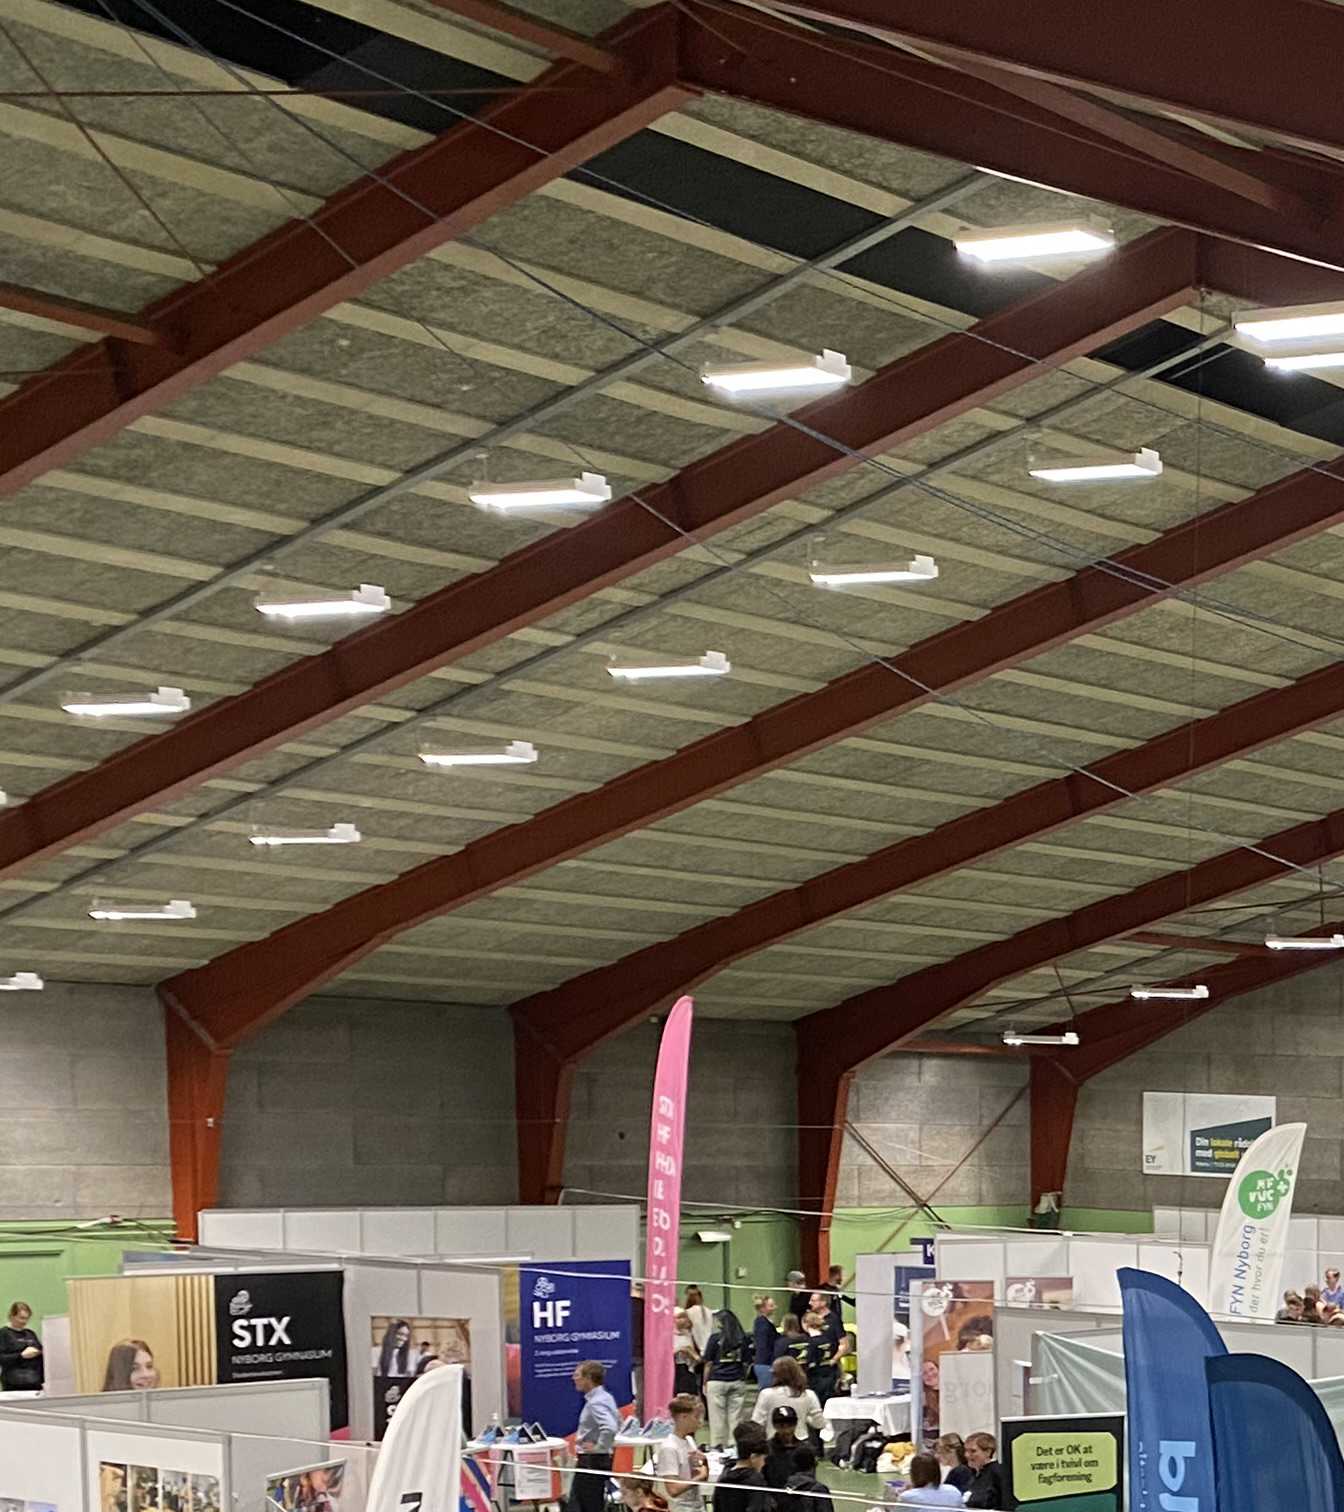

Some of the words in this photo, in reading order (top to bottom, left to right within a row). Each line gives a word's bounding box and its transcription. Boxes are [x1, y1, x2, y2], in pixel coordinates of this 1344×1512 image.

[1249, 1188, 1276, 1202] VUC
[1236, 1224, 1257, 1279] Nyborg
[532, 1300, 571, 1328] HF
[1229, 1285, 1244, 1315] FYN
[231, 1316, 292, 1349] STX
[232, 1353, 273, 1364] NYBORG
[1036, 1445, 1053, 1457] Det
[1066, 1443, 1082, 1455] OK
